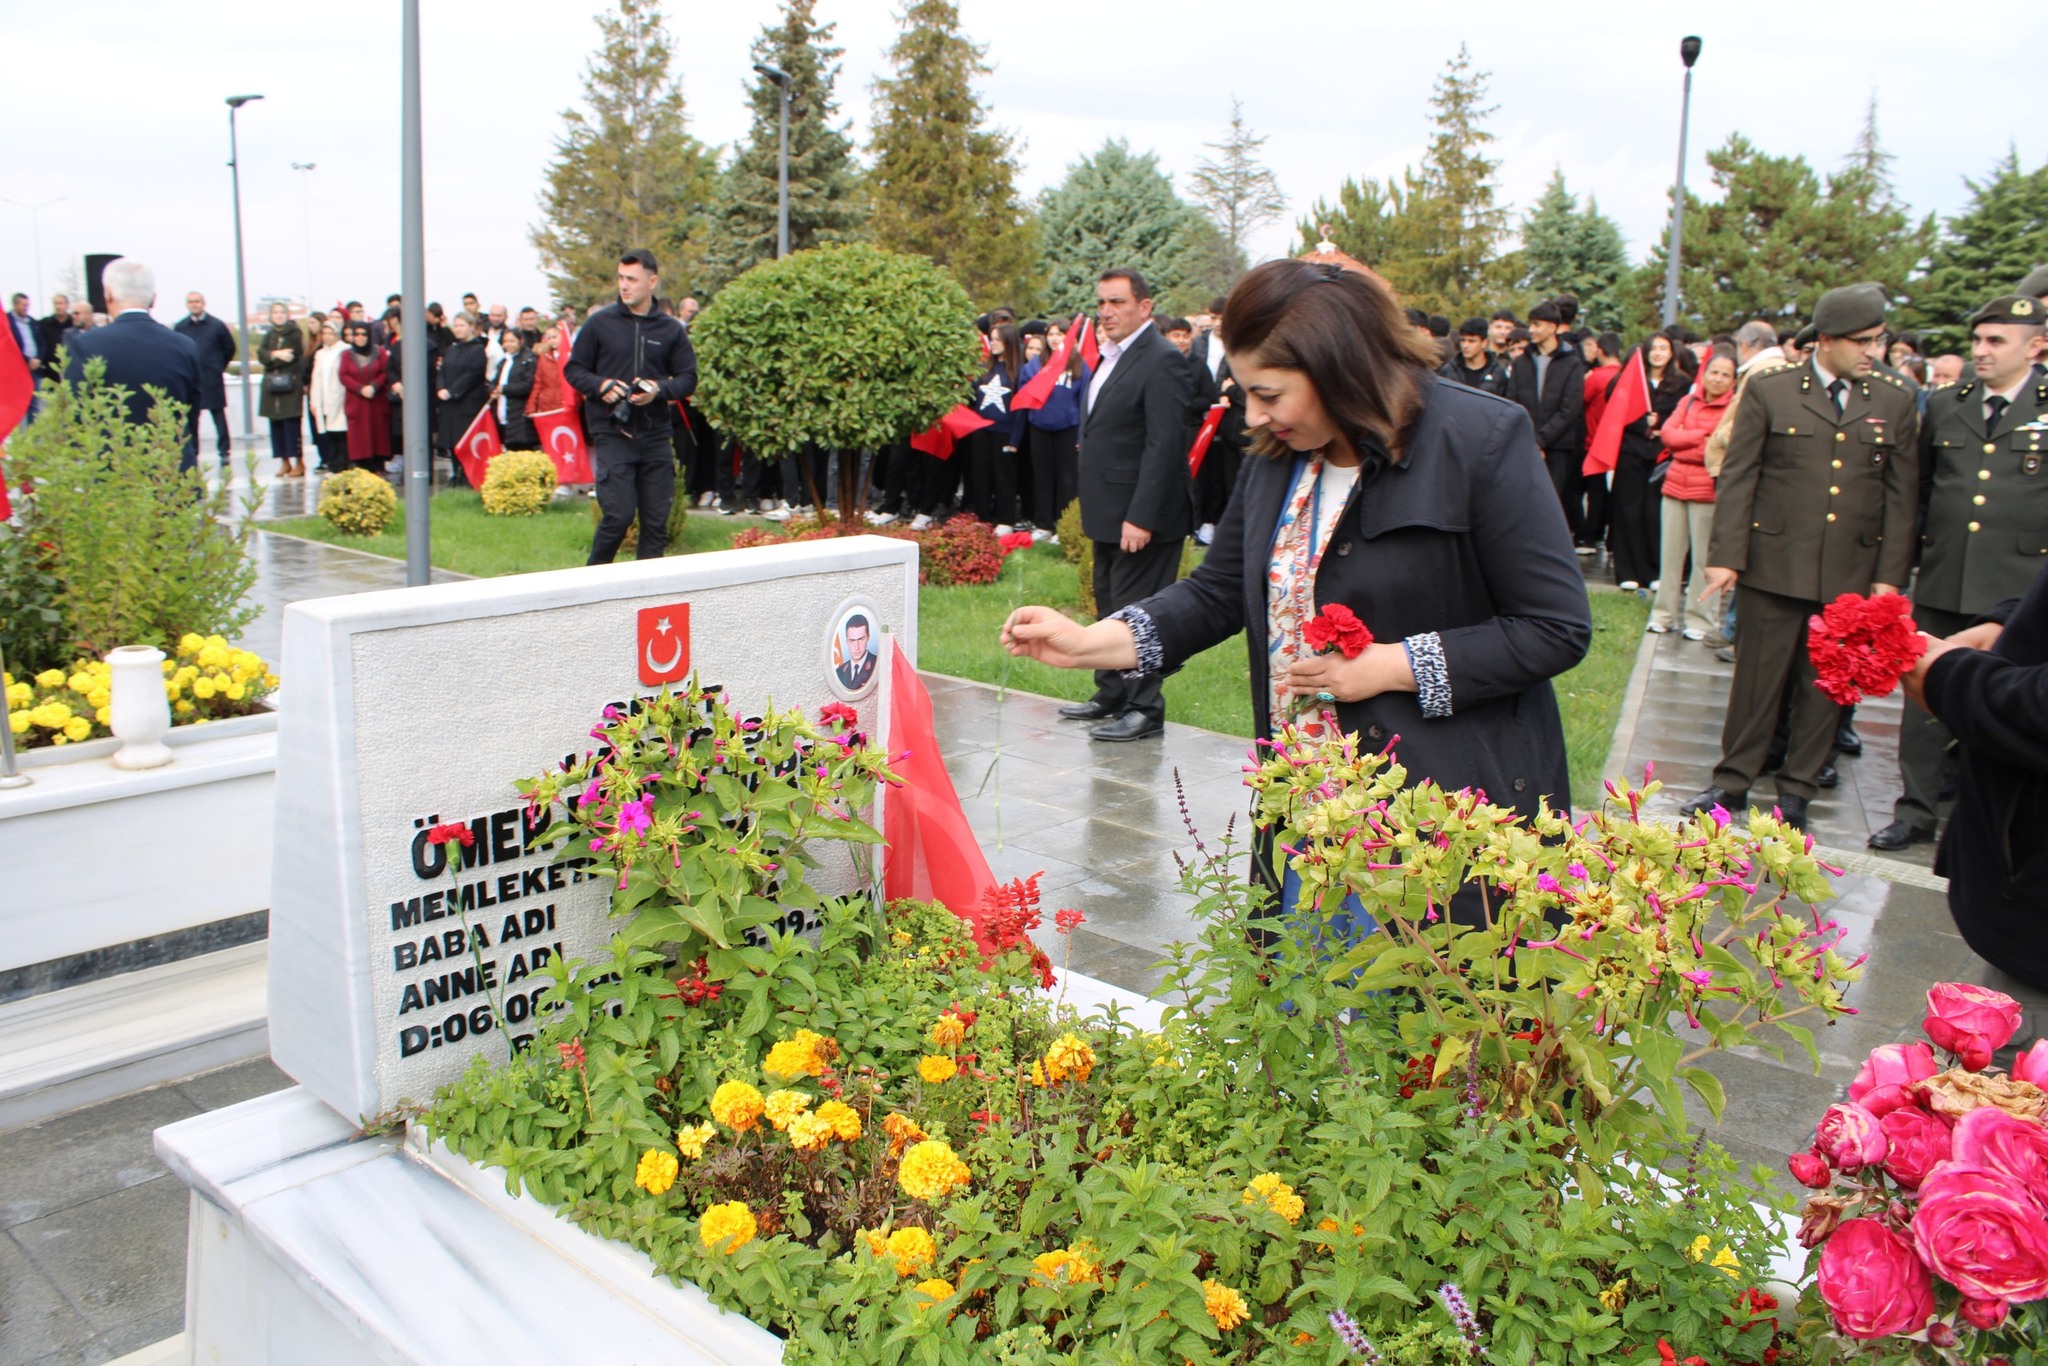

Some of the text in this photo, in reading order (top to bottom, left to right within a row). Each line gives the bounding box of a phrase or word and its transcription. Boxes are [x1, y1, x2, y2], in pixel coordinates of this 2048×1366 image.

[393, 904, 556, 971] BABA ADI
[399, 961, 498, 1015] ANNE
